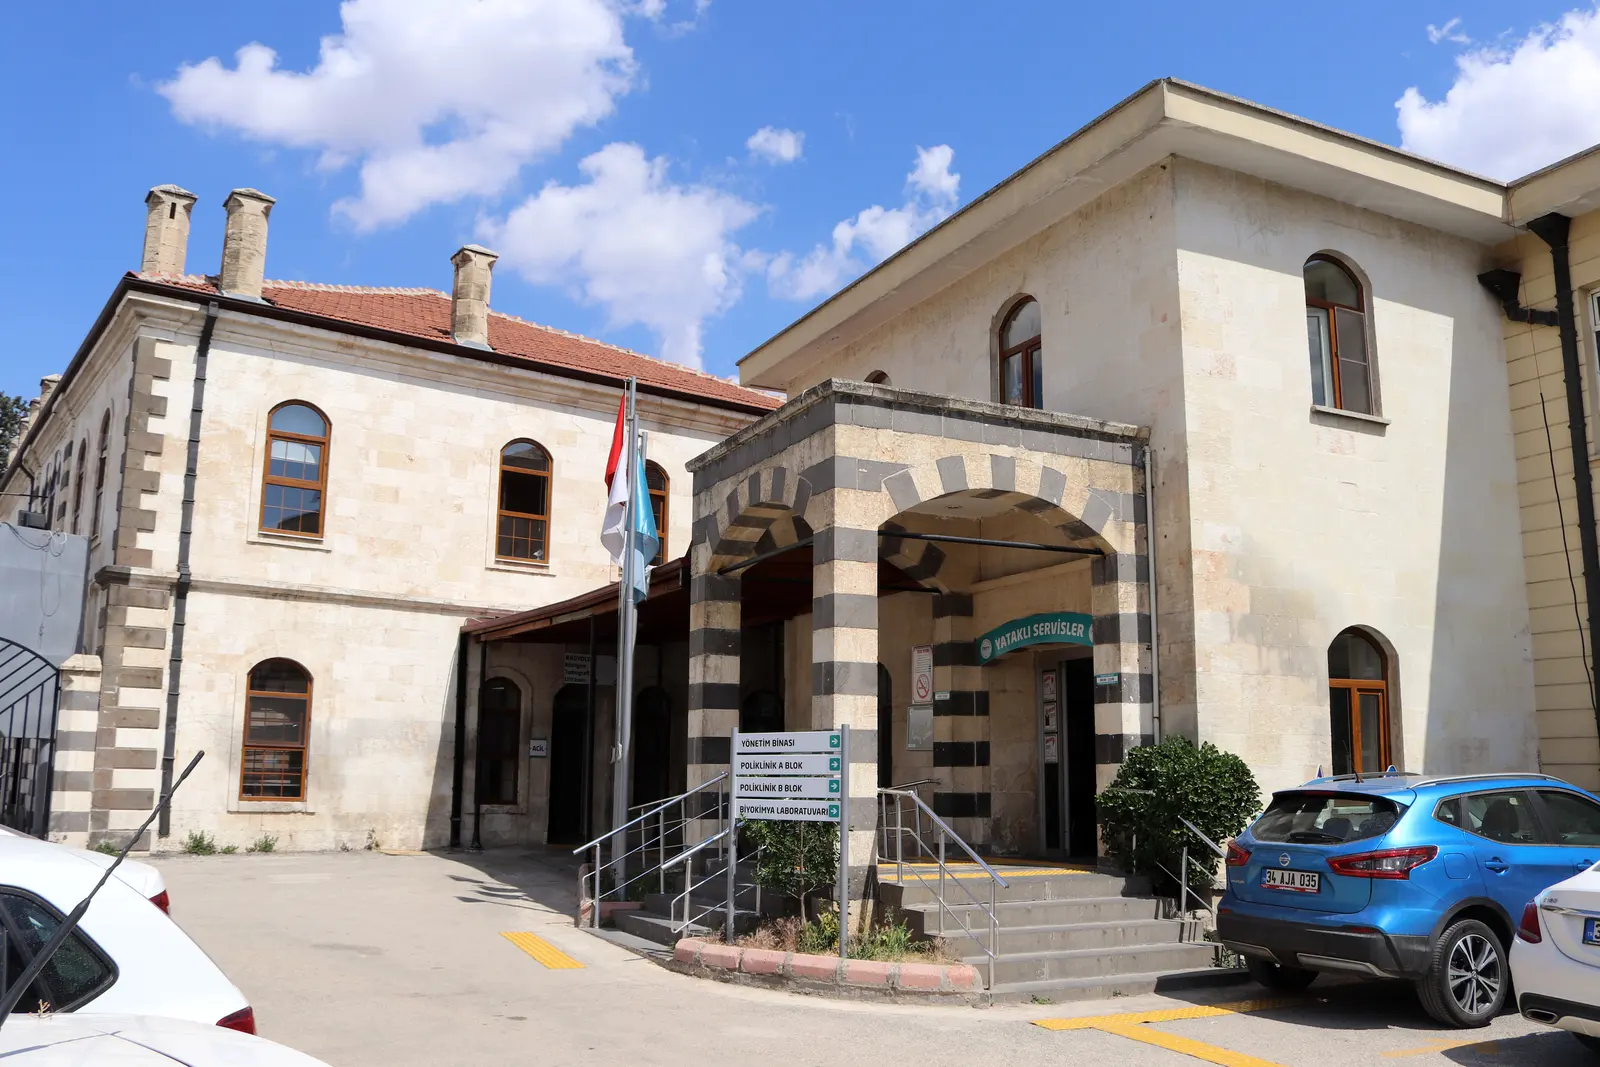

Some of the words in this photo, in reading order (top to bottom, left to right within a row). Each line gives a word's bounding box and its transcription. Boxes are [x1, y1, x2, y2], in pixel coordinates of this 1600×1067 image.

[994, 626, 1031, 650] YATAKLI
[1033, 618, 1085, 638] SERVİSLER
[741, 738, 771, 748] YÖNETİM
[772, 738, 795, 747] BİNASI
[741, 761, 777, 770] POLİKLİNİK
[785, 762, 803, 770] BLOK
[740, 783, 776, 792] POLİKLİNİK
[778, 784, 783, 792] B
[784, 784, 802, 793] BLOK
[739, 804, 775, 815] BİYOKİMYA
[776, 806, 829, 816] LABORATUVARI
[1266, 871, 1276, 884] 34
[1279, 872, 1296, 886] AJA
[1299, 874, 1317, 888] 035
